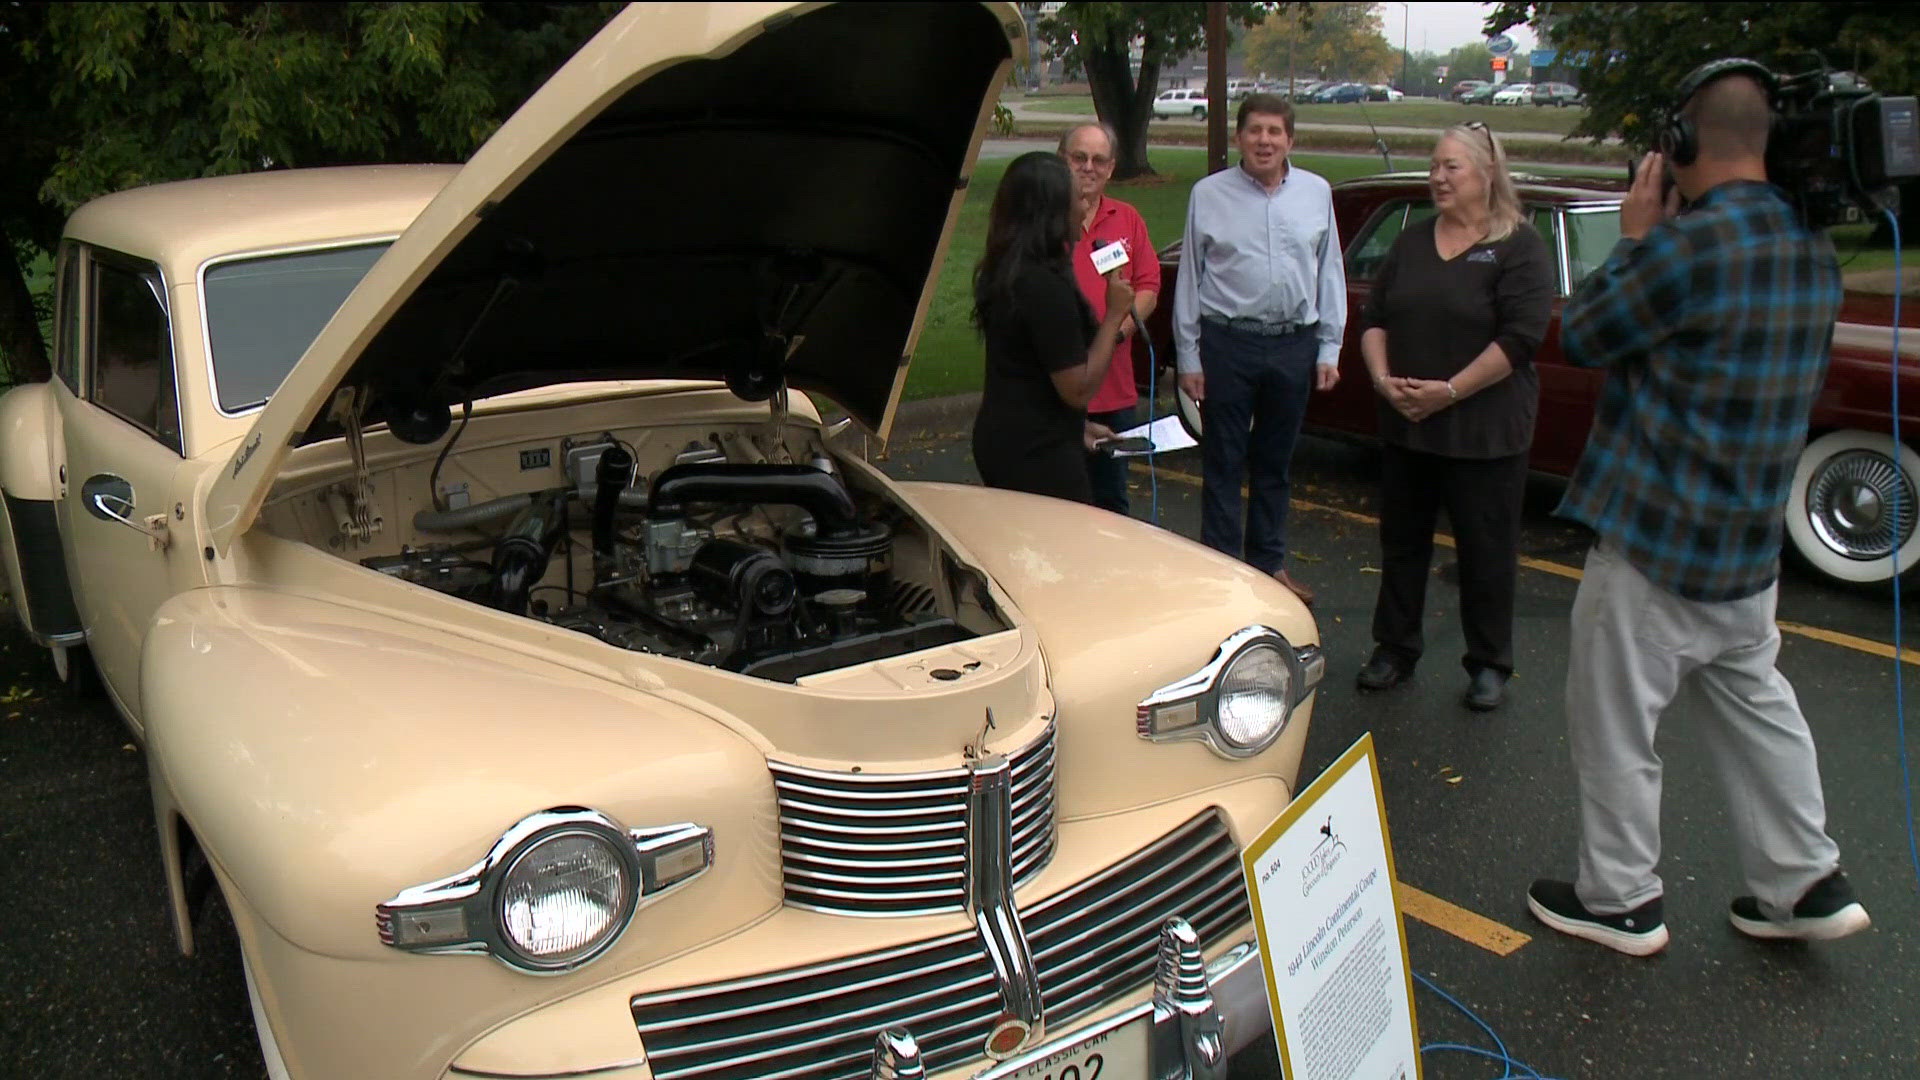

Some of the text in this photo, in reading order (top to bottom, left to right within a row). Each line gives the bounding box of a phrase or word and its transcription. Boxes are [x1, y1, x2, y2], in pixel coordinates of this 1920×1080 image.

[1262, 858, 1281, 885] no. 504
[1288, 868, 1377, 977] 1942 Lincoln Continental Coupe
[1311, 907, 1363, 970] Winston Peterson
[1028, 1033, 1108, 1076] CLASSIC CAR
[1044, 1053, 1104, 1080] 02
